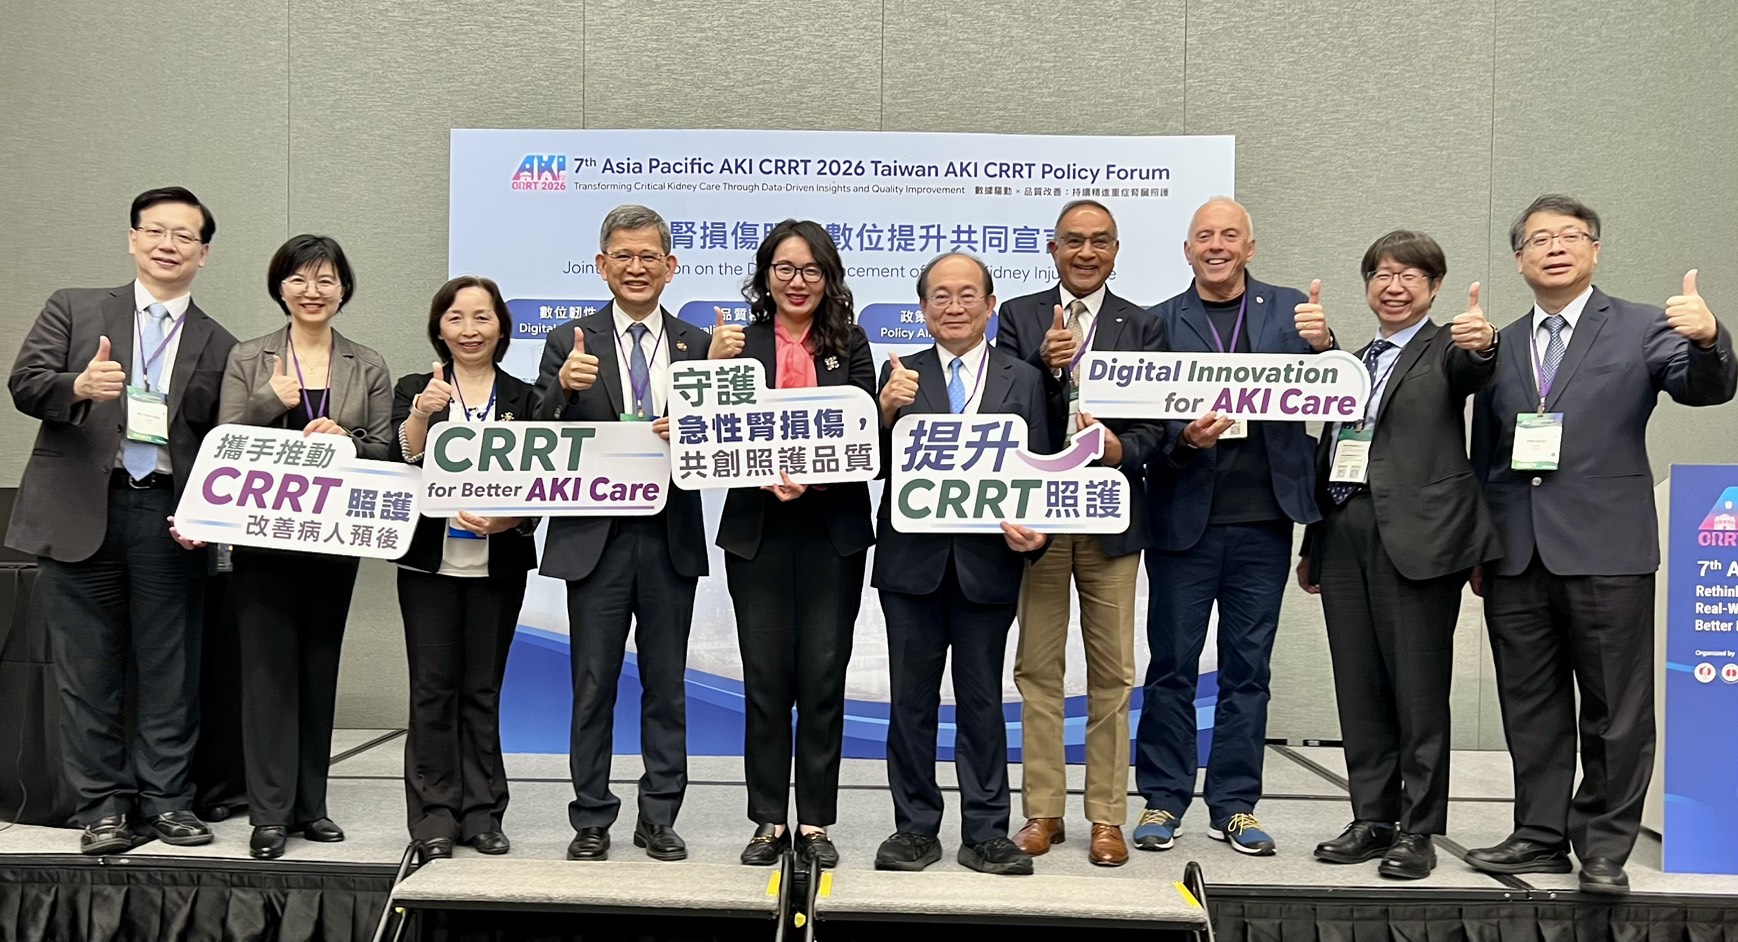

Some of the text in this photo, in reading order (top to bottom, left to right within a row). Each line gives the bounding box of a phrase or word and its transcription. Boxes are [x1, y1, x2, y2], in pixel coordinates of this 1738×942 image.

[512, 154, 566, 181] AKI
[574, 157, 1170, 184] 7th Asia Pacific AKI CRRT 2026 Taiwan AKI CRRT Policy Forum
[542, 181, 566, 191] 2026
[575, 182, 632, 193] Transforming
[634, 182, 666, 191] Critical
[668, 182, 697, 192] Kidney
[699, 182, 721, 191] Care
[723, 183, 760, 194] Through
[762, 183, 814, 192] Data-Driven
[816, 184, 850, 194] Insights
[853, 185, 870, 193] and
[872, 185, 903, 195] Quality
[906, 186, 965, 195] Improvement
[695, 265, 714, 276] on
[719, 263, 743, 276] the
[880, 328, 914, 340] Policy
[673, 365, 757, 407] 守護
[1089, 359, 1338, 388] Digital Innovation
[1165, 387, 1357, 416] for AKI Care
[213, 433, 337, 469] 攜手推動
[434, 426, 596, 473] CRRT
[901, 420, 1020, 472] 提升
[679, 443, 874, 480] 共創照護品質
[202, 466, 414, 523] CRRT 照護
[427, 476, 660, 502] for Better AKI Care
[245, 515, 400, 550] 改善病人預後
[1696, 559, 1722, 577] 7th
[1694, 619, 1734, 632] Better
